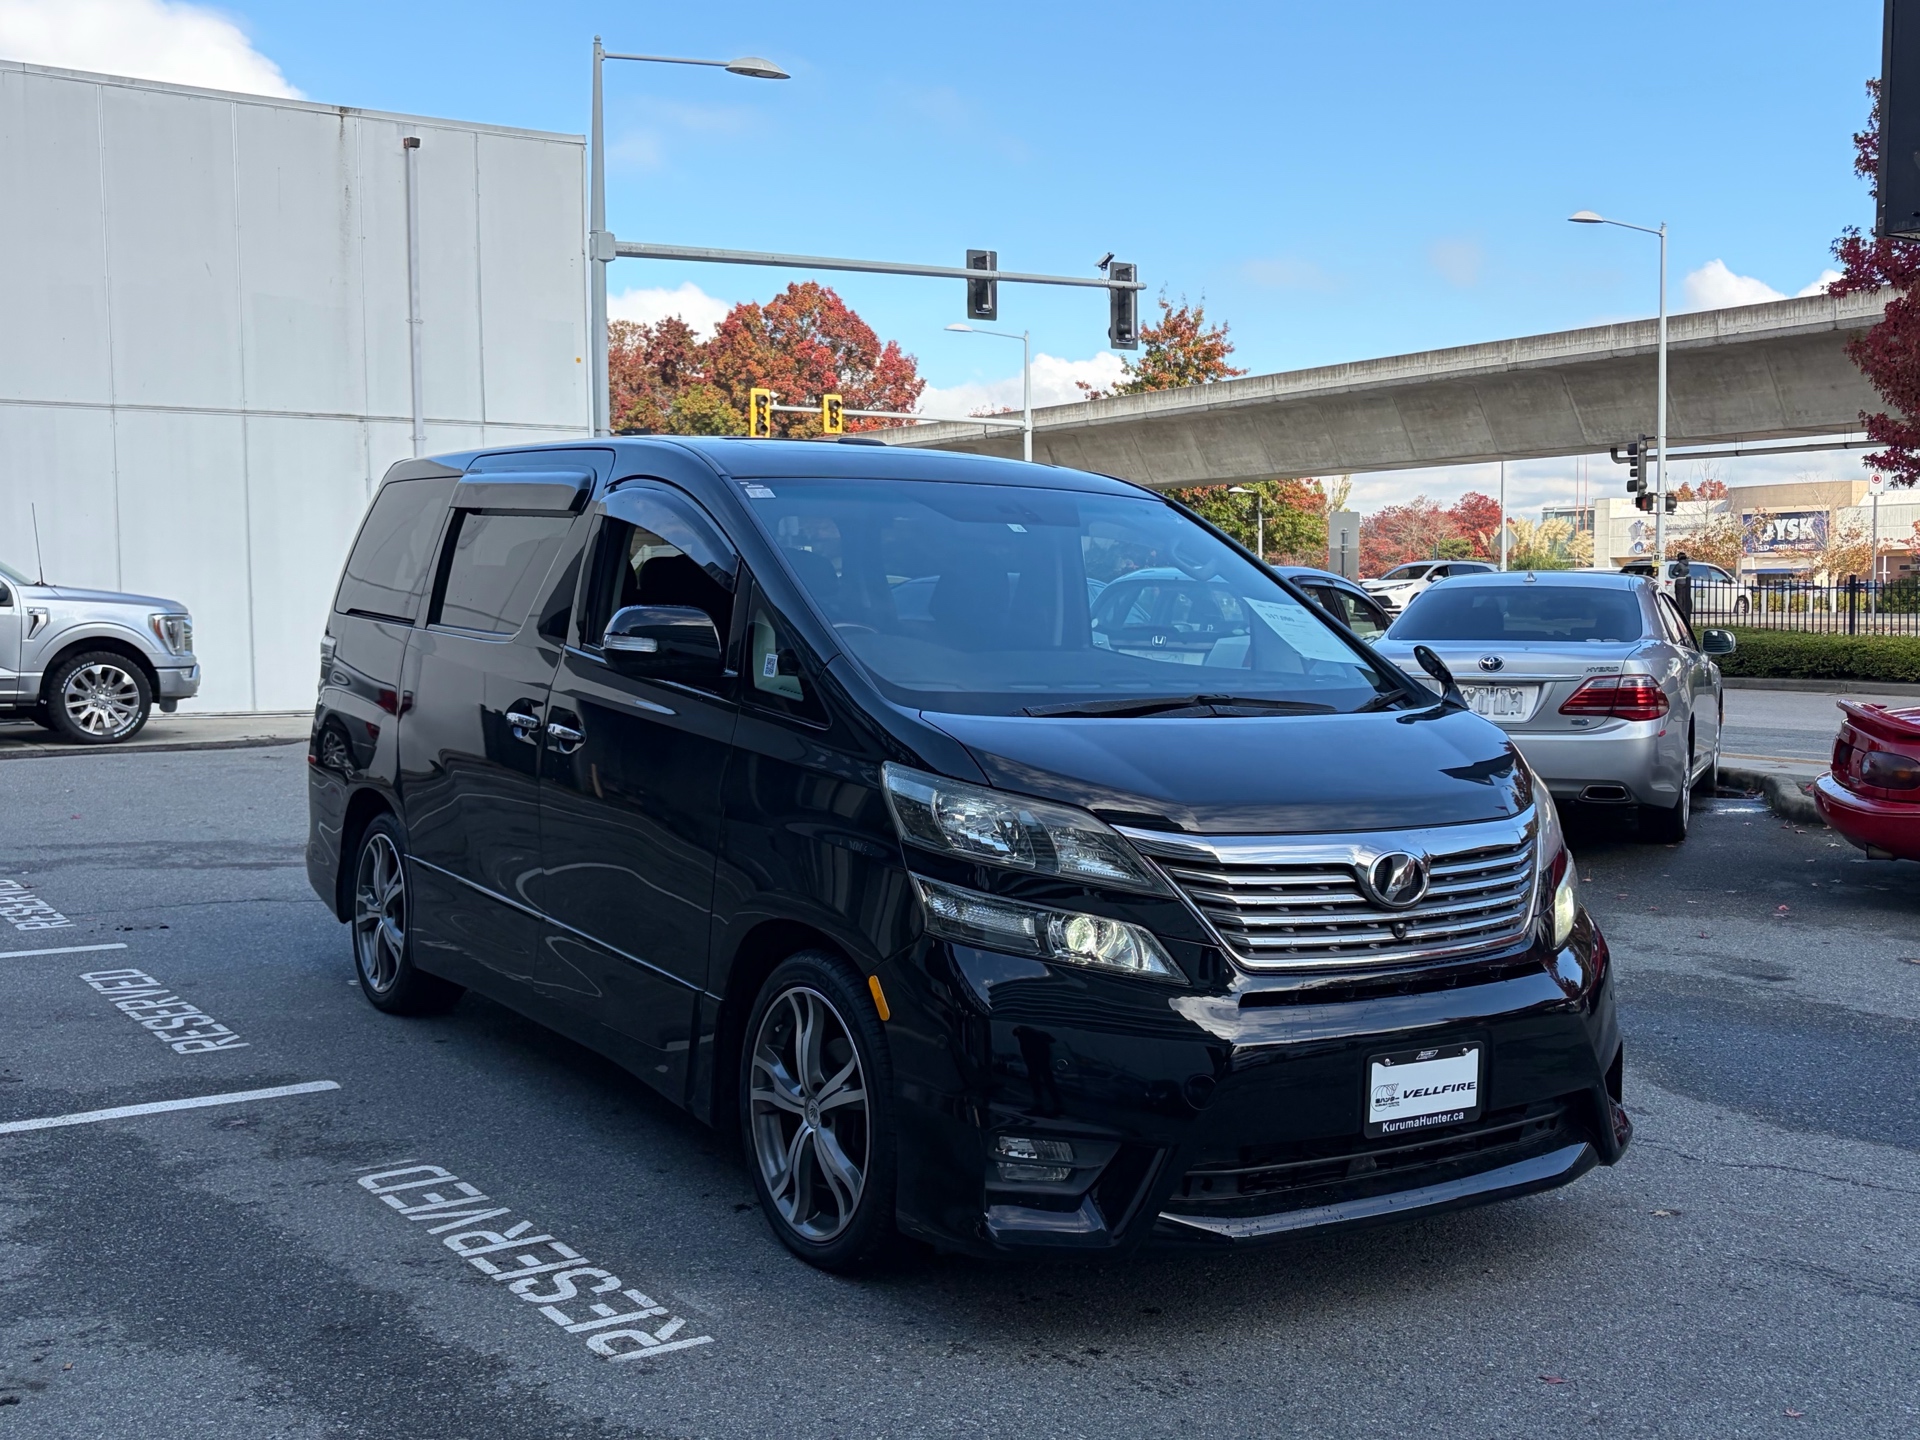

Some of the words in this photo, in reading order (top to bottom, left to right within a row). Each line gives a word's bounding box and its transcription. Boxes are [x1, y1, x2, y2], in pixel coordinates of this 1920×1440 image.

[1762, 518, 1816, 541] JYSK
[79, 968, 250, 1054] RESERVED
[1403, 1081, 1476, 1099] VELLFIRE
[1382, 1111, 1465, 1133] KurumaHunter.ca
[357, 1164, 715, 1363] RESERVED
